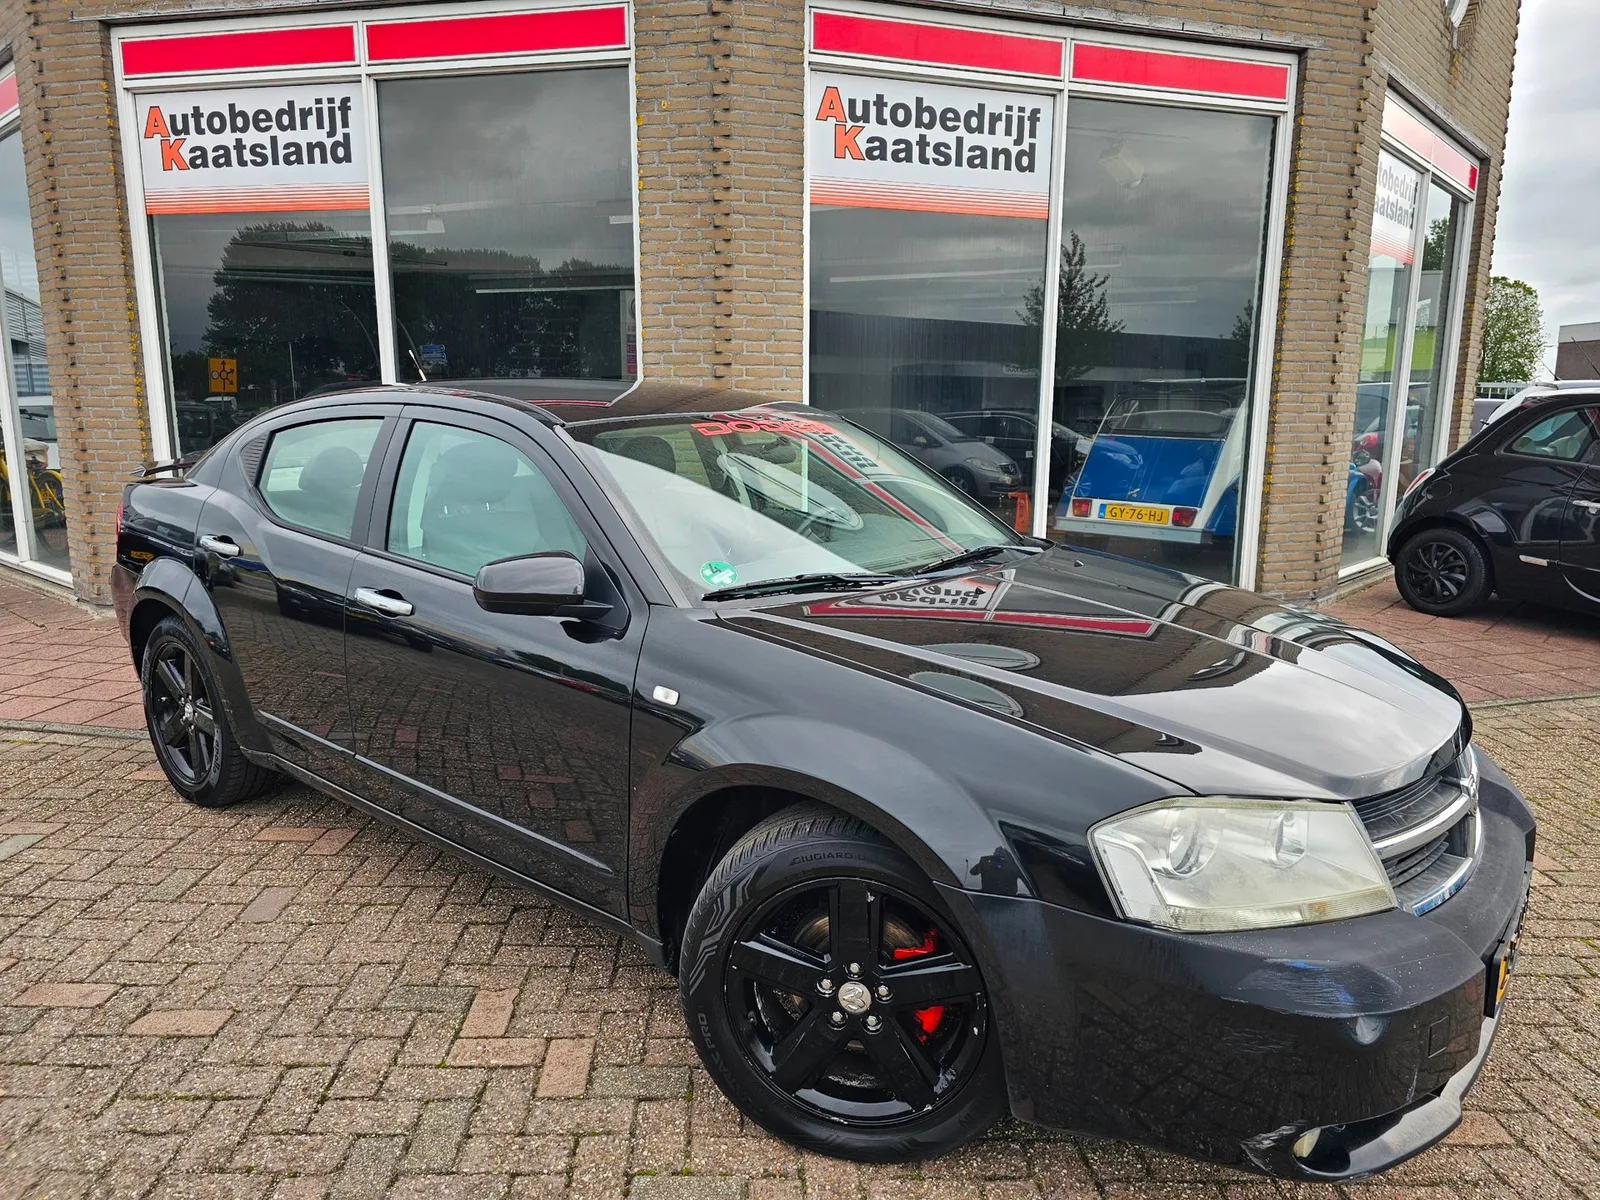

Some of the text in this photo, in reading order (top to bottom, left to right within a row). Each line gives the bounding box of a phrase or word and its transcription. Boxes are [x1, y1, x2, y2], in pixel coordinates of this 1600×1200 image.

[144, 96, 351, 138] Autobedrijf
[816, 86, 1041, 146] Autobedrijf
[160, 132, 352, 171] Kaatsland
[834, 124, 1036, 173] Kaatsland
[1109, 507, 1164, 522] GY-76-HJ
